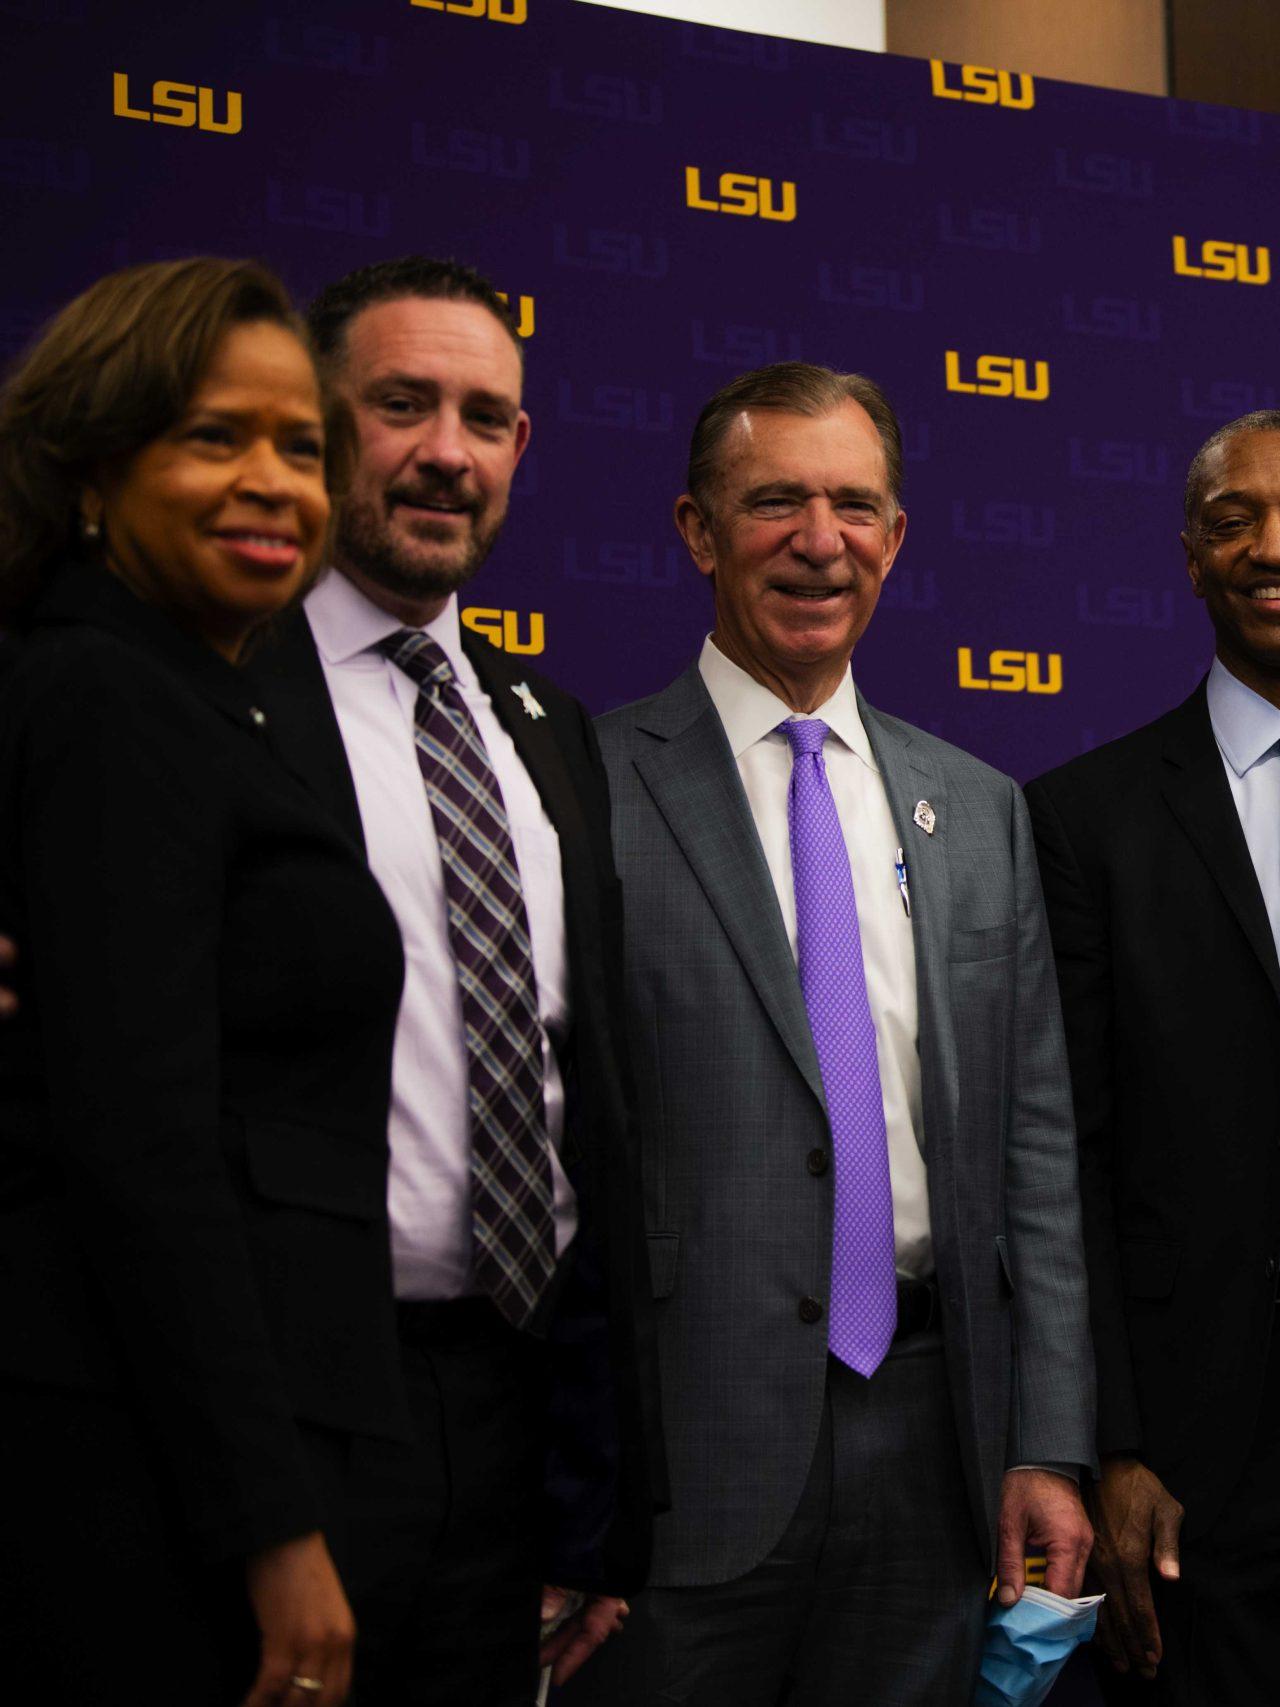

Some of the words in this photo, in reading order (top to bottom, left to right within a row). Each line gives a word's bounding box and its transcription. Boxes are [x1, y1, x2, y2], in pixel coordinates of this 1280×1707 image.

[265, 14, 389, 76] LSU
[113, 73, 242, 134] LSU
[548, 66, 663, 125] LSU
[929, 58, 1035, 110] LSU
[411, 119, 530, 180] LSU
[811, 111, 918, 165] LSU
[685, 166, 798, 222] LSU
[1054, 145, 1154, 198] LSU
[265, 176, 392, 239] LSU
[937, 201, 1041, 253] LSU
[553, 222, 669, 279] LSU
[1172, 235, 1271, 285] LSU
[817, 261, 925, 313] LSU
[1062, 292, 1162, 343] LSU
[945, 350, 1050, 401] LSU
[558, 377, 672, 432] LSU
[1068, 436, 1168, 484] LSU
[952, 498, 1055, 546] LSU
[563, 536, 679, 587] LSU
[461, 606, 545, 656] SU
[1077, 581, 1177, 630] LSU
[957, 647, 1063, 694] LSU
